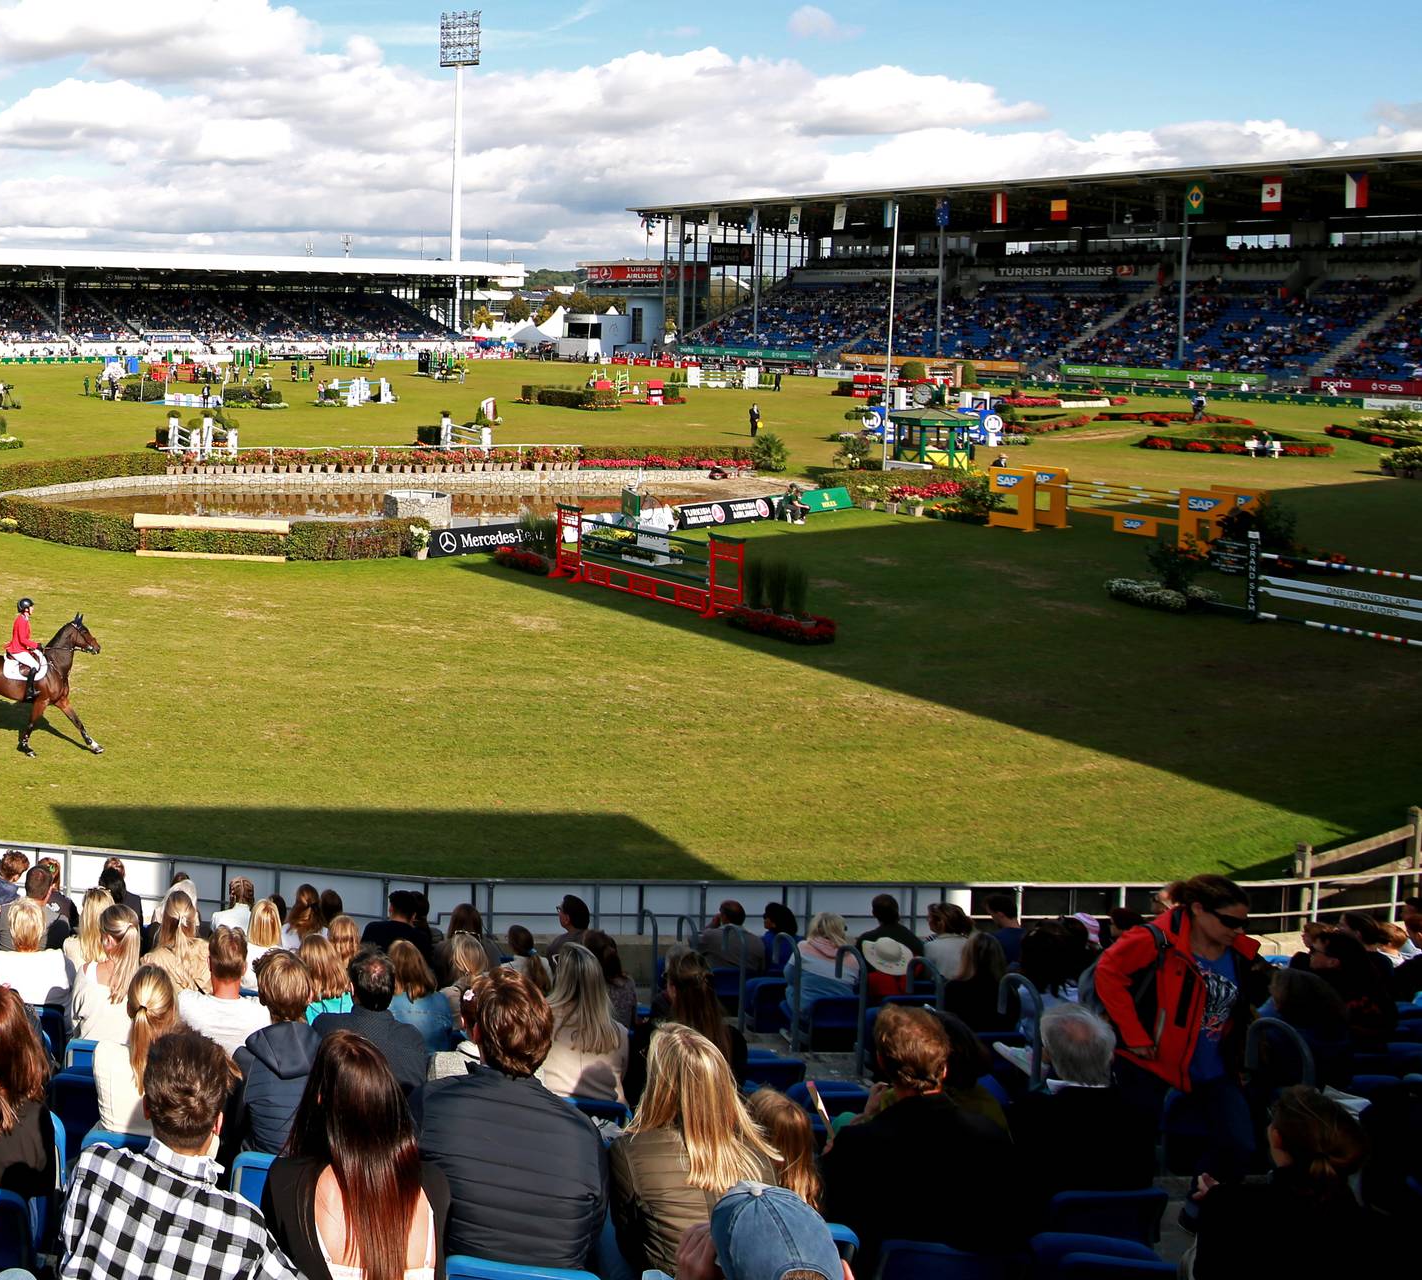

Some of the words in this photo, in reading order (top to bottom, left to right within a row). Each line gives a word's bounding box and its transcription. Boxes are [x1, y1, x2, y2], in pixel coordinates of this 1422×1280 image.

[999, 267, 1051, 276] TURKISH
[1057, 266, 1113, 276] AIRLINES
[747, 350, 763, 358] porta
[1067, 367, 1090, 375] porta
[1186, 373, 1213, 382] porta
[1321, 379, 1352, 389] porta
[997, 475, 1018, 486] SAP
[1036, 474, 1050, 483] AP
[729, 502, 756, 512] TURKISH
[1188, 498, 1215, 511] SAP
[683, 506, 711, 518] TURKISH
[733, 509, 759, 519] AIRLINES
[686, 514, 714, 525] AIRLINES
[1123, 520, 1142, 529] SAP
[1248, 582, 1256, 612] SLAM
[1326, 587, 1345, 596] ONE
[1346, 590, 1382, 602] GRAND
[1383, 595, 1409, 606] SLAM
[1333, 599, 1358, 610] FOUR
[1360, 604, 1401, 617] MAJORS
